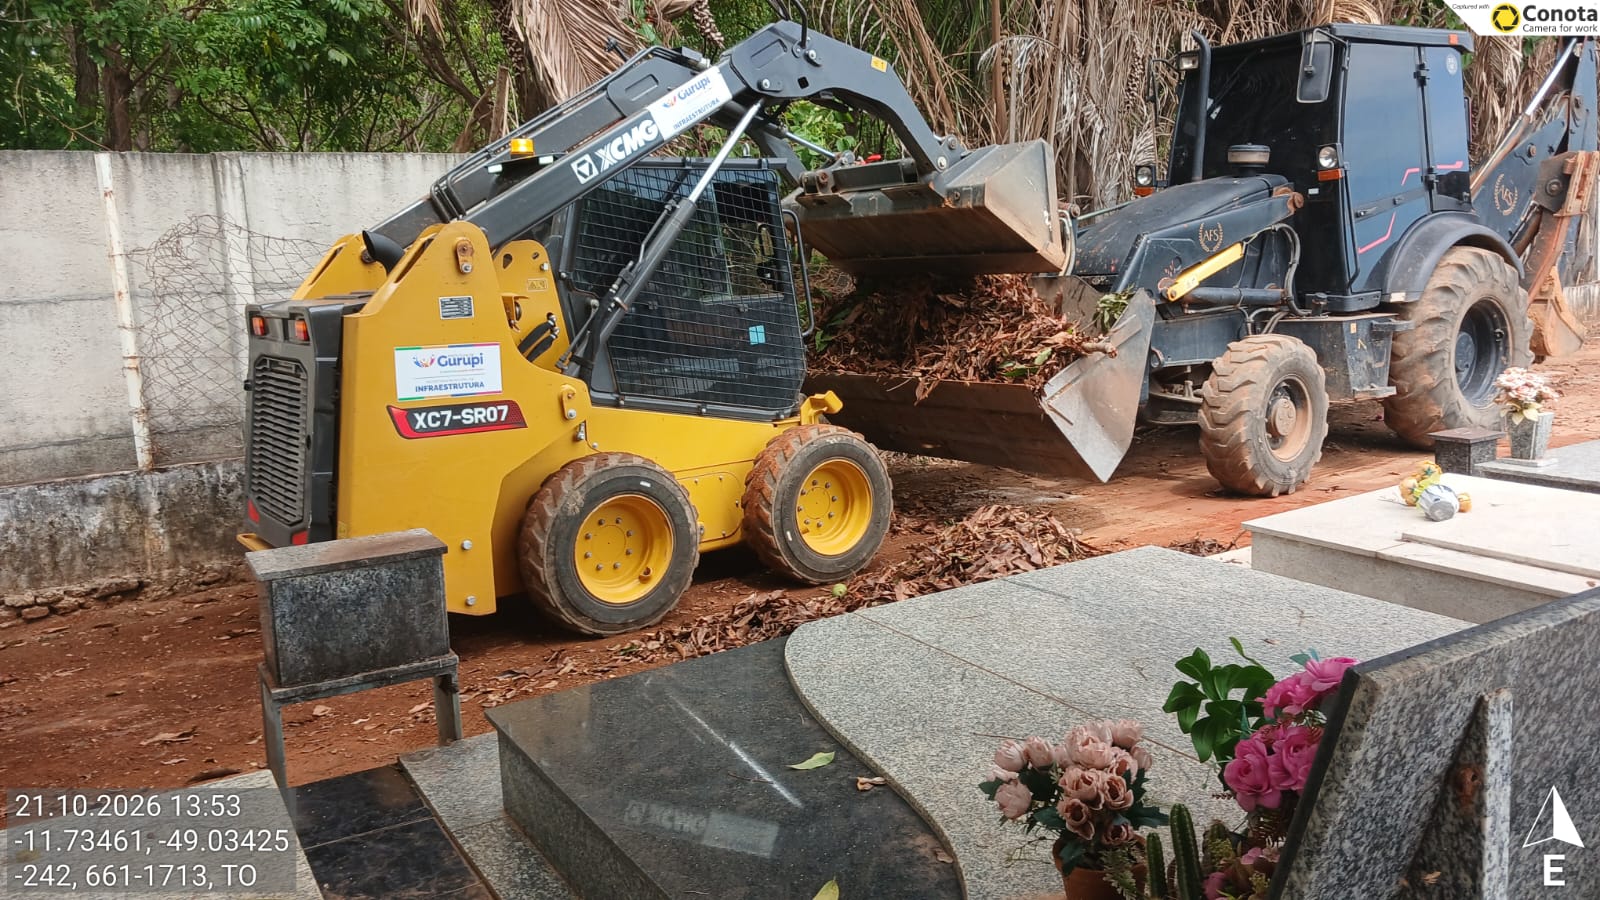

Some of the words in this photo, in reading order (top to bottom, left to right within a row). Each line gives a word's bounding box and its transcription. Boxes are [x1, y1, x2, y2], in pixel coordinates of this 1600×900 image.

[678, 76, 711, 101] Gurupi
[673, 97, 720, 130] INFRAESTRUTURA
[595, 119, 659, 173] XCMG
[1203, 229, 1219, 242] AFS
[437, 352, 484, 368] Gurupi
[415, 381, 485, 393] INFRAESTRUTURA
[414, 405, 509, 430] XC7-SR07
